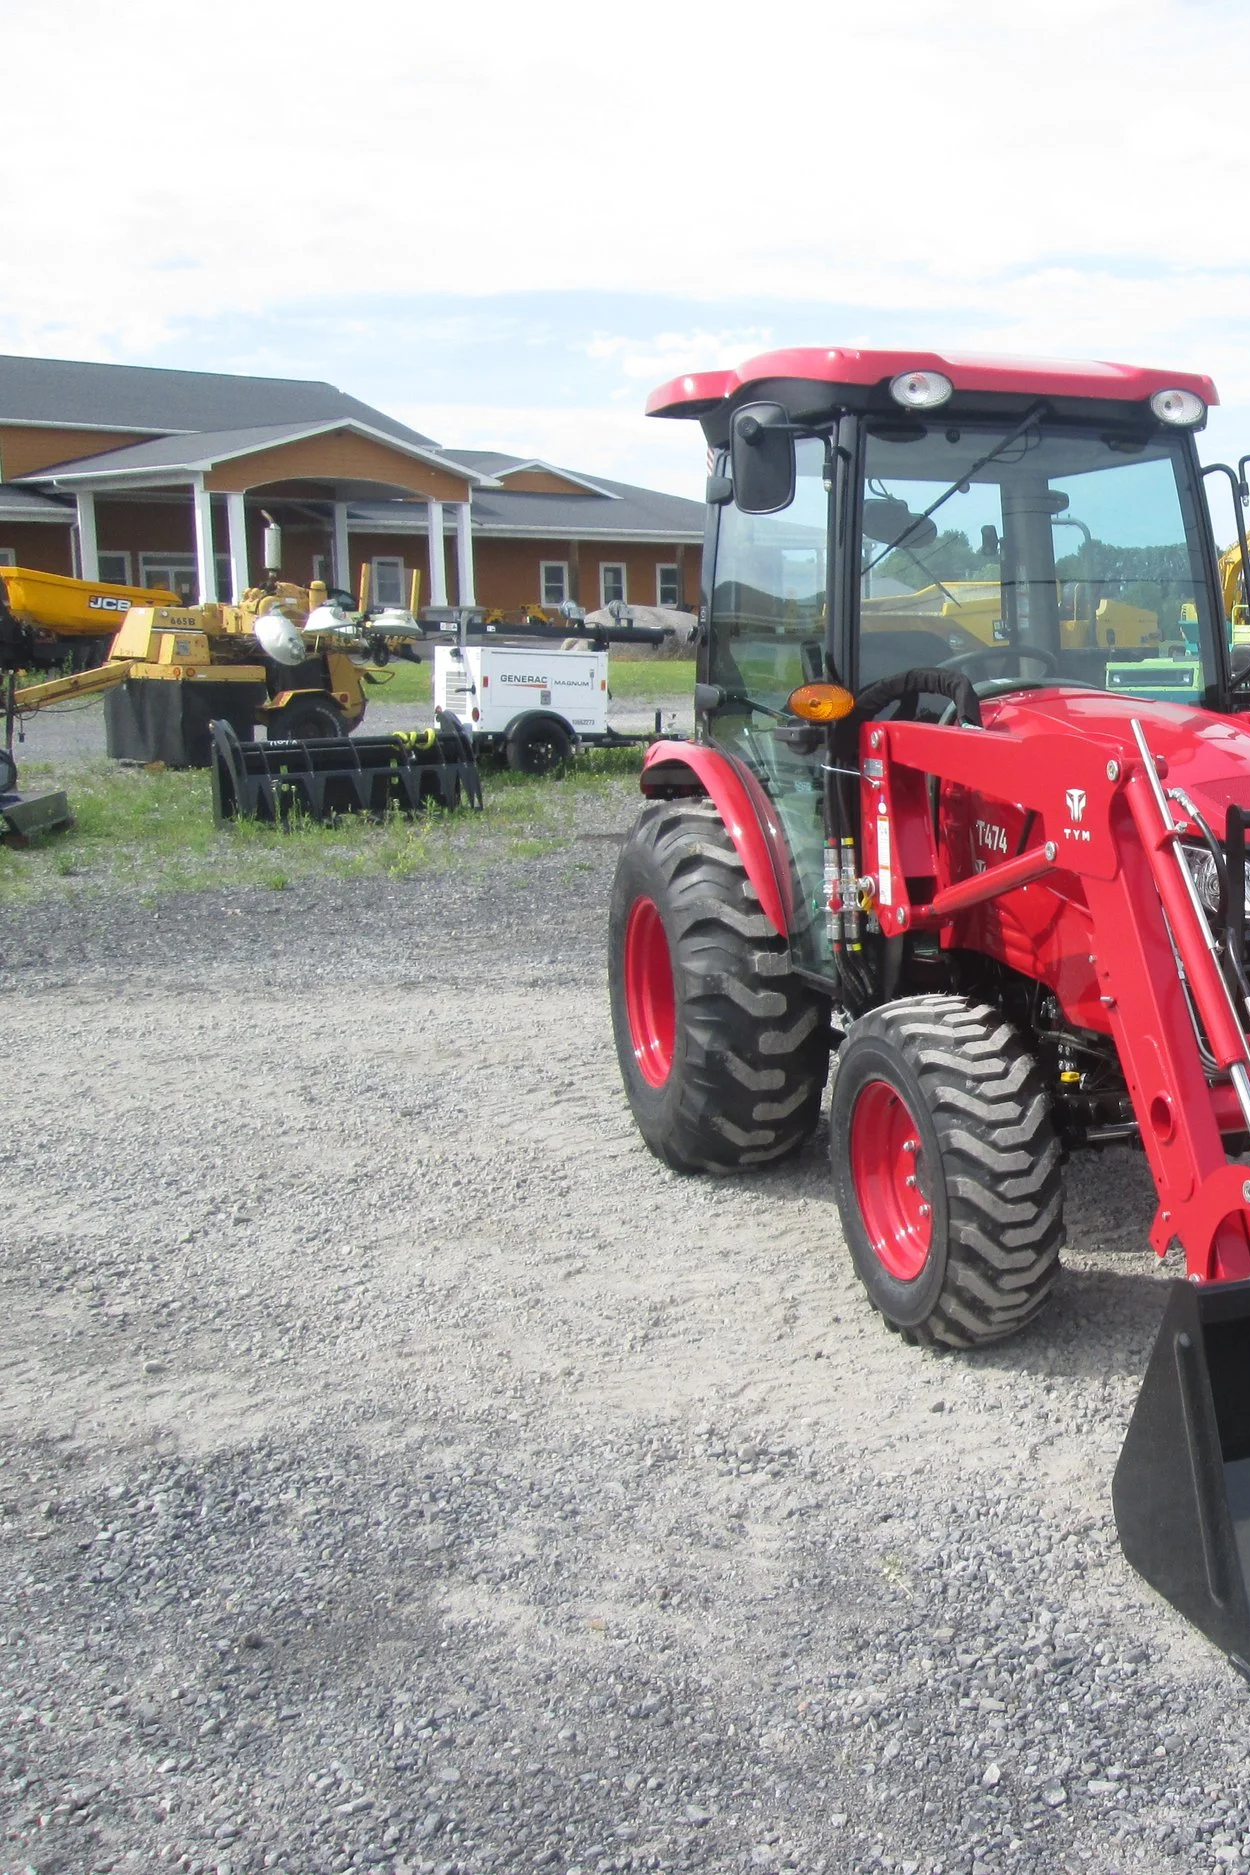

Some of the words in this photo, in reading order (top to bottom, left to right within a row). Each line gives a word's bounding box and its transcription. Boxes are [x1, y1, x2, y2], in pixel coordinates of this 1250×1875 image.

[90, 597, 131, 611] JCB
[500, 674, 547, 683] GENERAC
[976, 819, 1008, 854] T474
[1063, 828, 1091, 841] TYM
